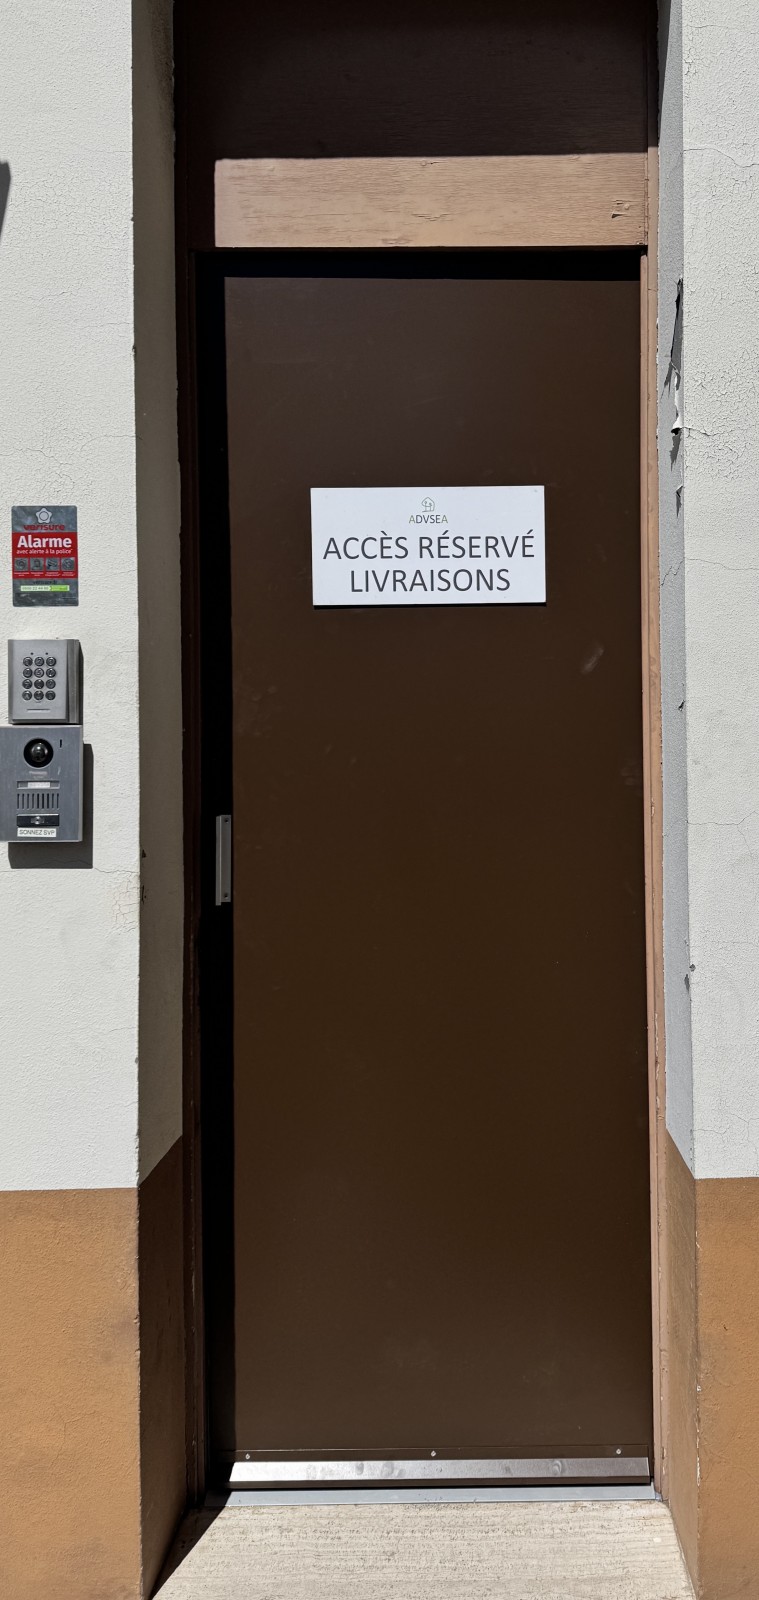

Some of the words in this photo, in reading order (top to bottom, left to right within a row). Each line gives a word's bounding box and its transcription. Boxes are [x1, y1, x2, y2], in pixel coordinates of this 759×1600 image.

[408, 514, 448, 524] ADVSEA
[17, 535, 72, 548] Alarme
[322, 530, 409, 560] ACCÈS
[418, 529, 535, 559] RÉSERVÉ
[350, 568, 511, 592] LIVRAISONS
